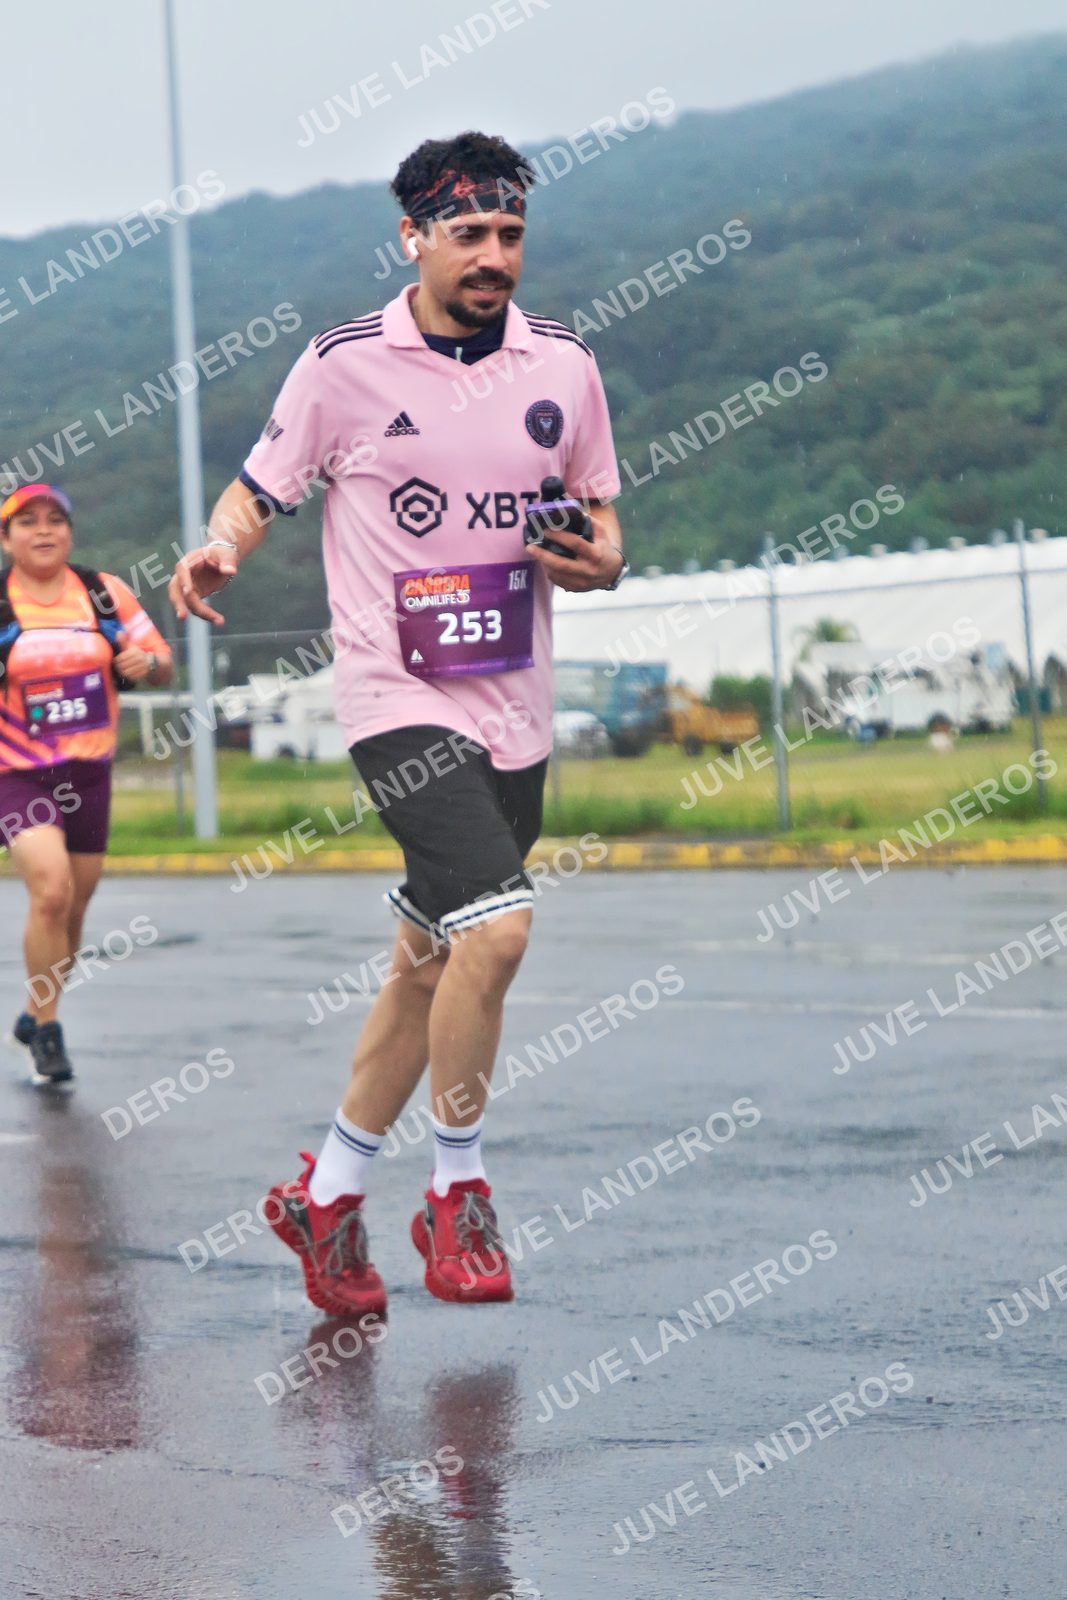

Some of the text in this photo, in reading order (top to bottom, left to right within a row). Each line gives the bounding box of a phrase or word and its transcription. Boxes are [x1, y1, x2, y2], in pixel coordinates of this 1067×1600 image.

[384, 426, 420, 437] adidas
[509, 569, 528, 590] 15K
[437, 609, 503, 645] 253
[46, 696, 88, 724] 235
